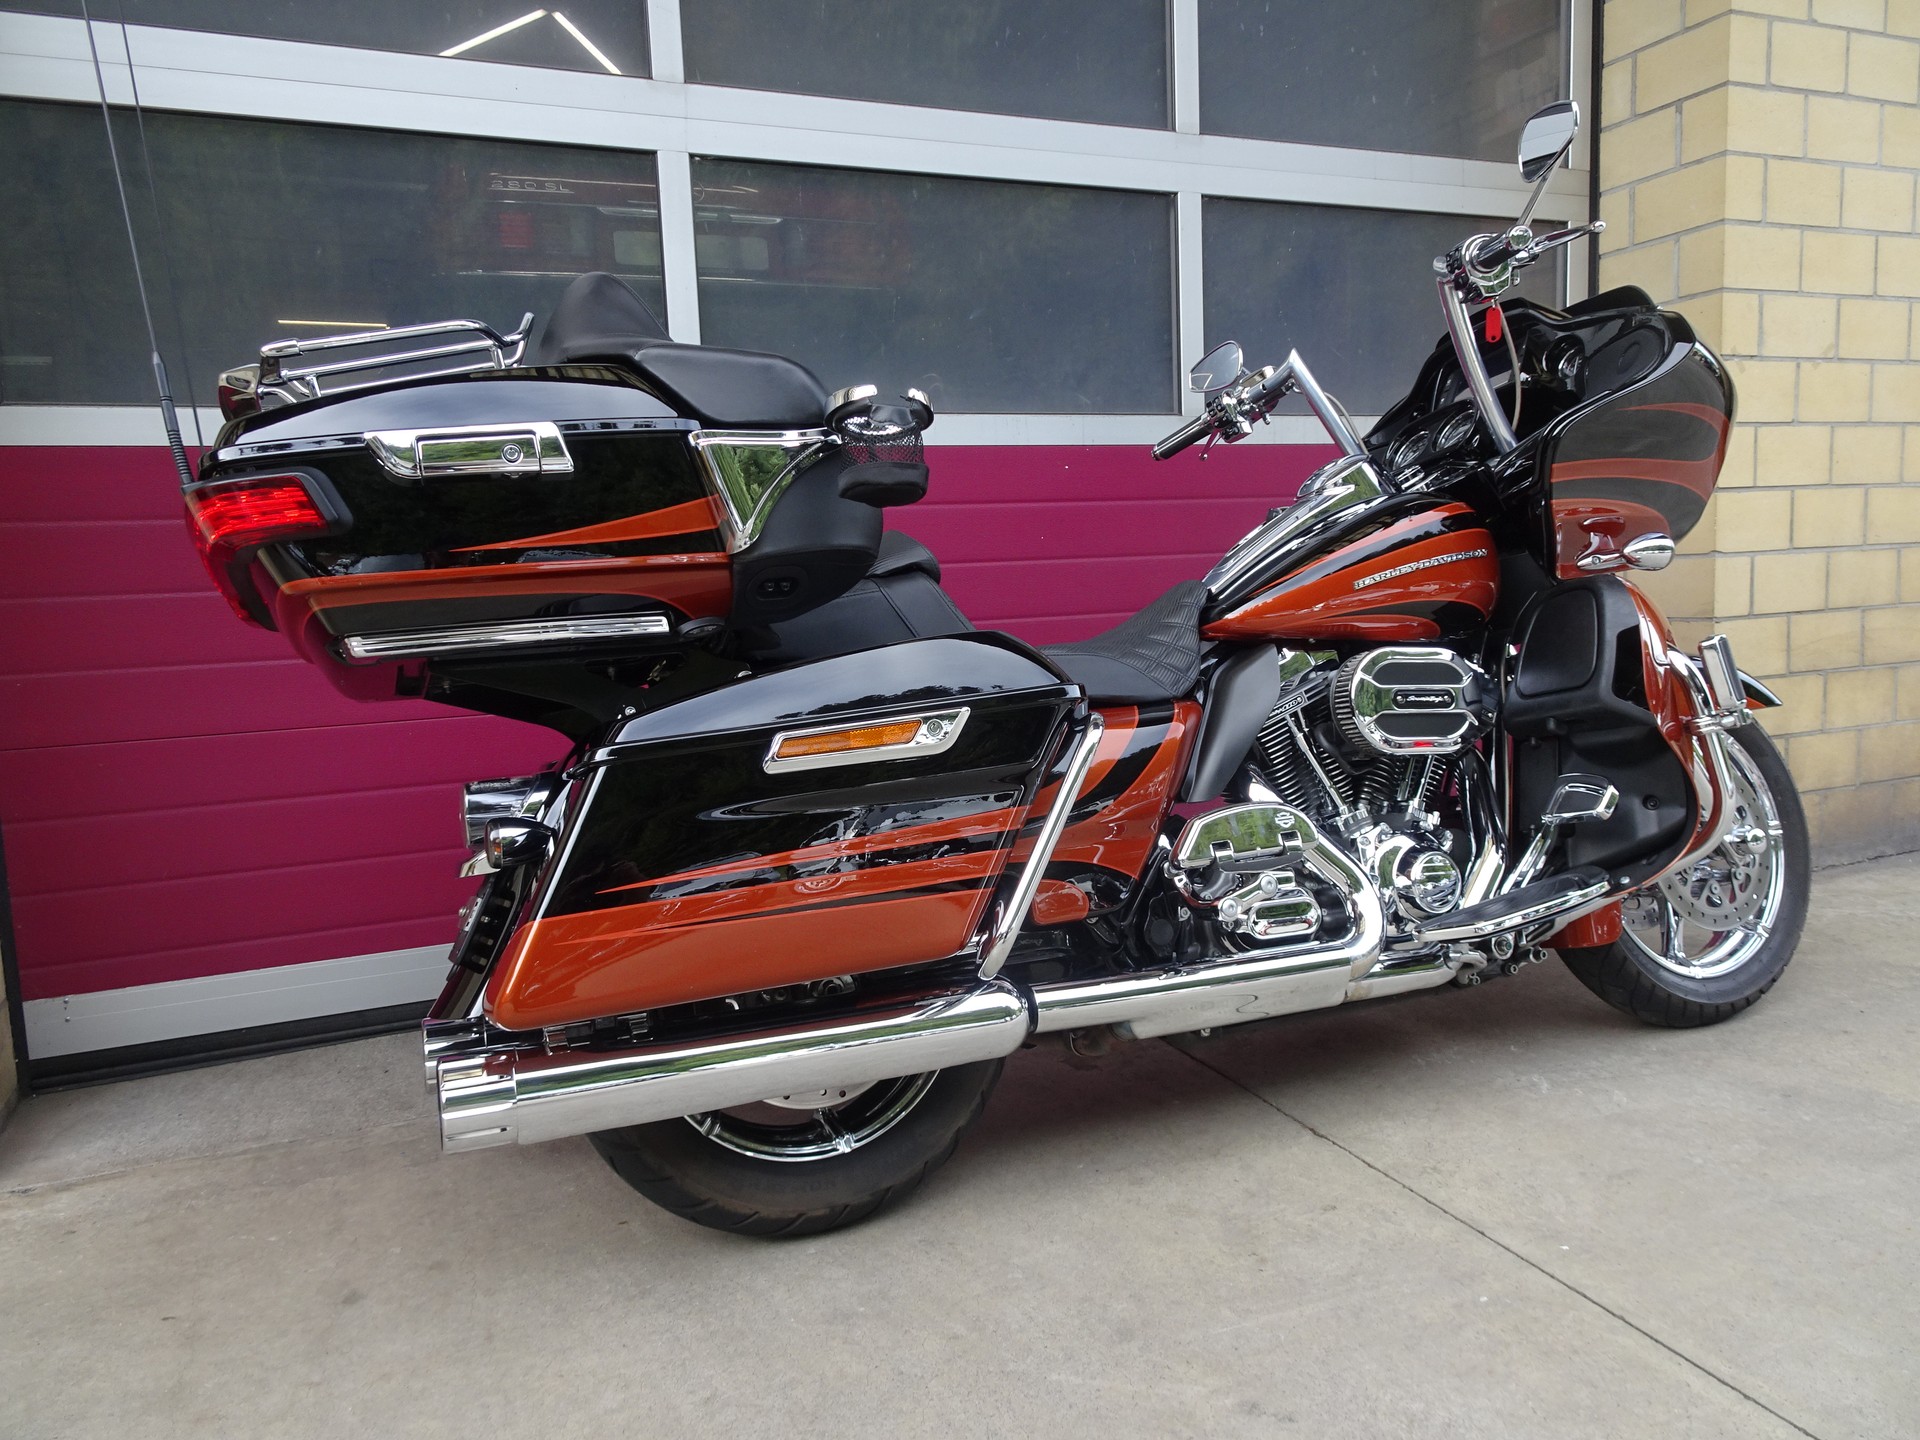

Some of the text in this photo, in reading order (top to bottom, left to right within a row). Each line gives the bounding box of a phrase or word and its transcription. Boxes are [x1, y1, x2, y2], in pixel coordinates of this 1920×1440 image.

[490, 180, 570, 192] 280 SL
[1353, 548, 1488, 590] HARLEY-DAVIDSON
